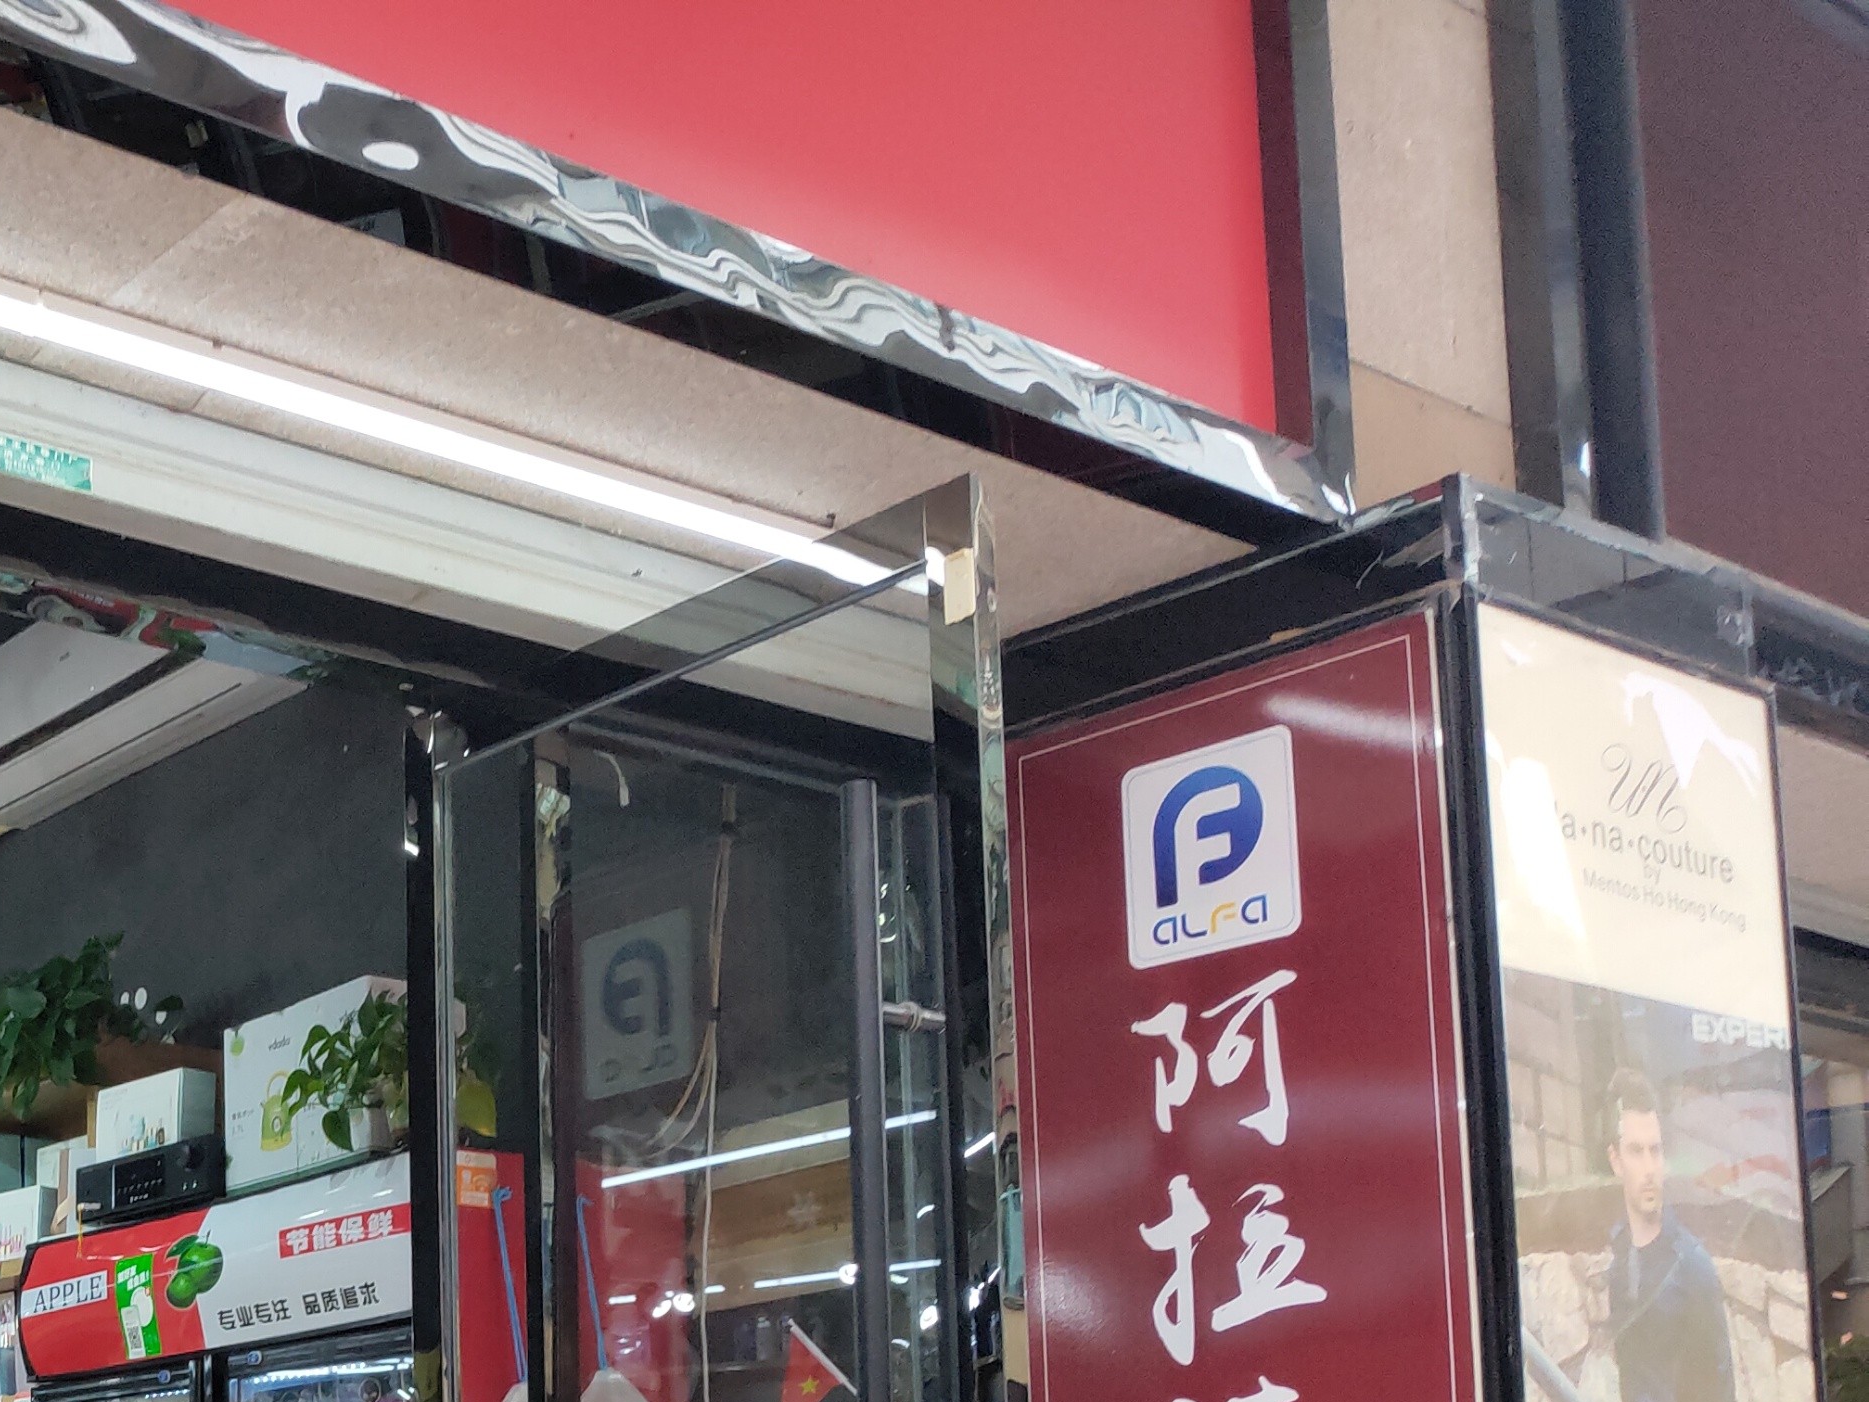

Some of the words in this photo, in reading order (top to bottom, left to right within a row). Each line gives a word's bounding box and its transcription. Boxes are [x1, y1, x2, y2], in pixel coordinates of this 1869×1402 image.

[1669, 893, 1707, 923] Hong
[1710, 903, 1747, 933] Kong
[285, 1208, 396, 1256] 节能保鲜
[32, 1273, 105, 1316] APPLE
[301, 1281, 381, 1317] 品质追求
